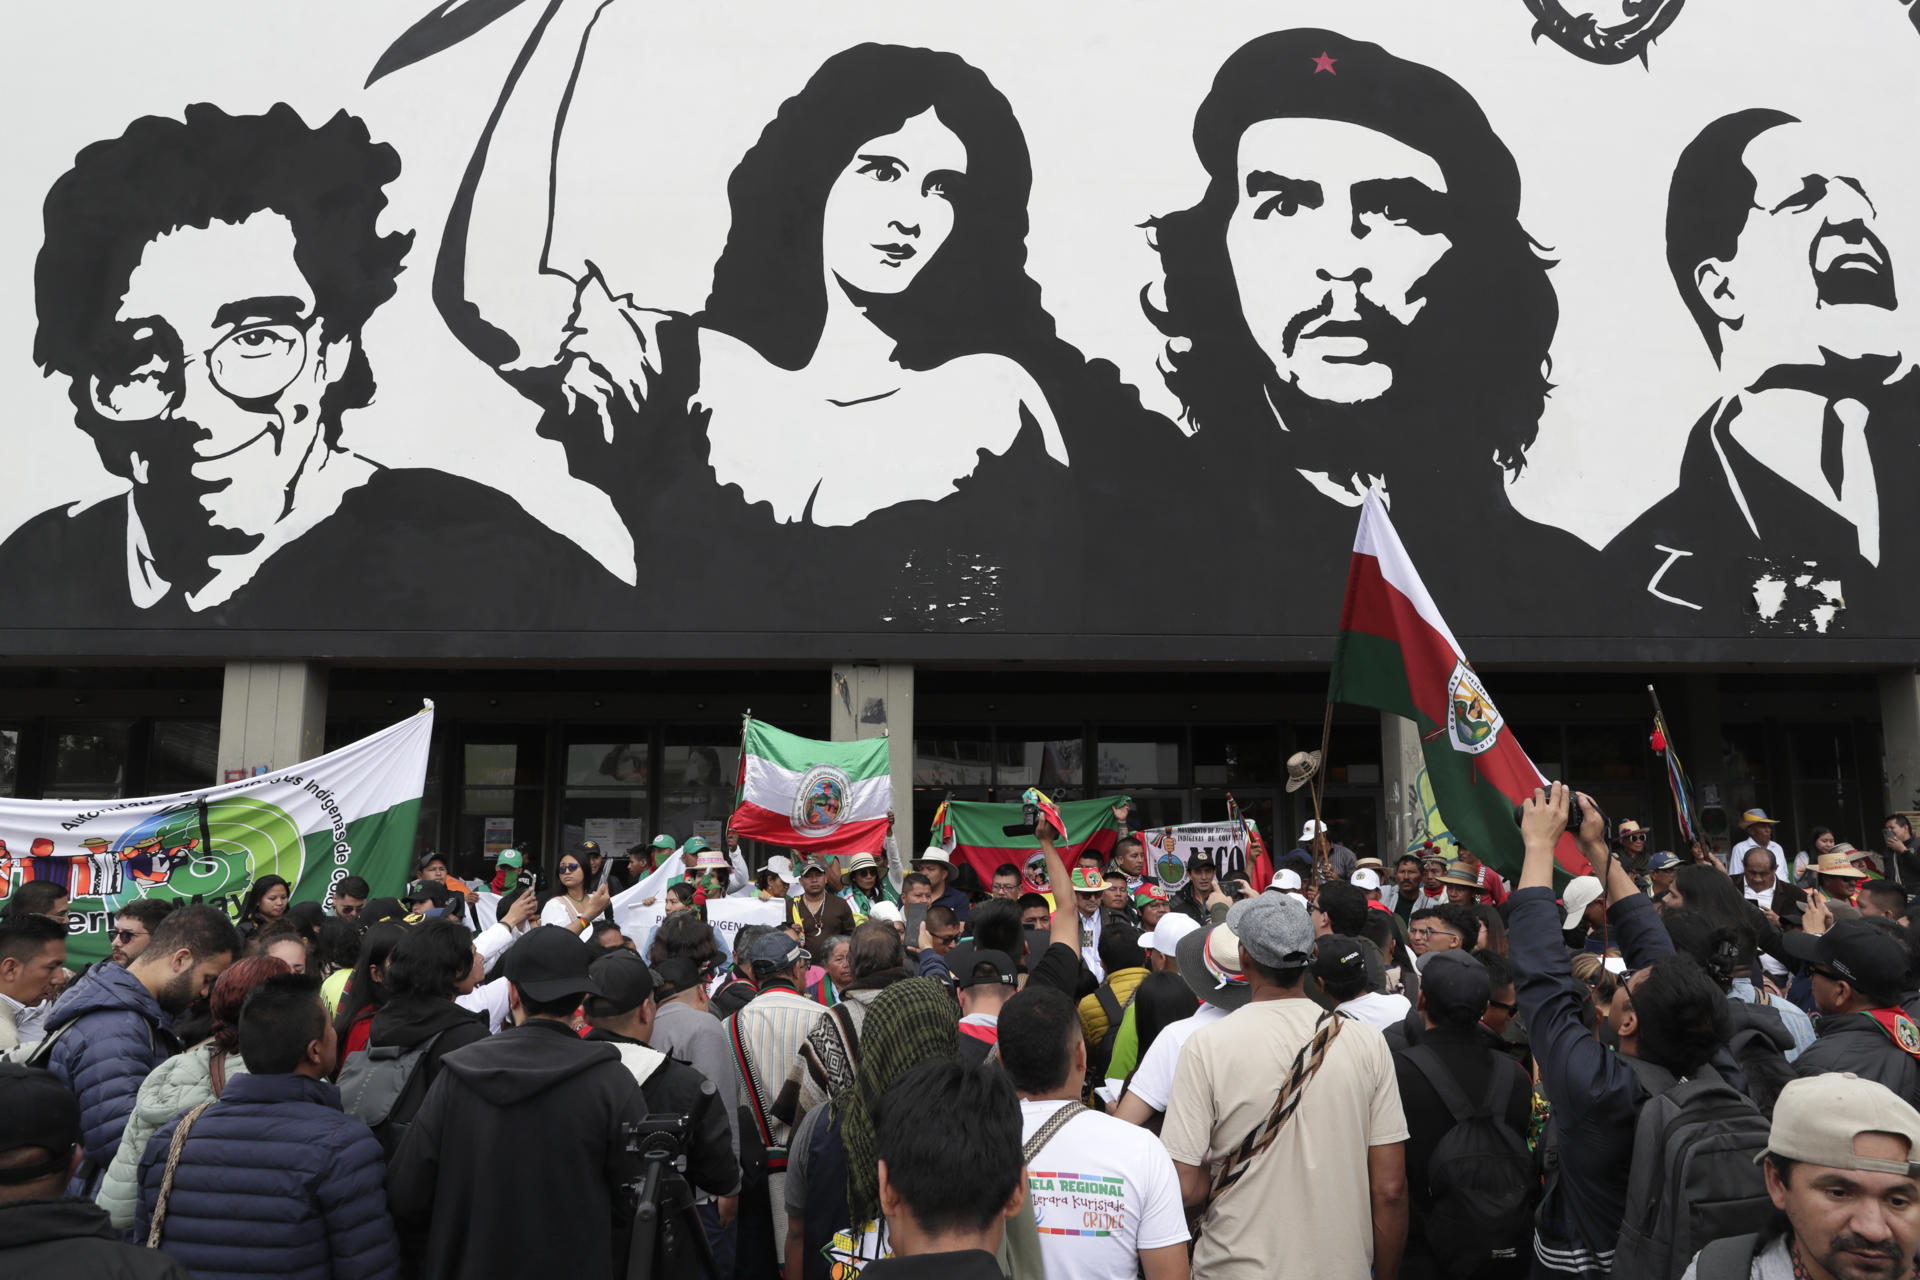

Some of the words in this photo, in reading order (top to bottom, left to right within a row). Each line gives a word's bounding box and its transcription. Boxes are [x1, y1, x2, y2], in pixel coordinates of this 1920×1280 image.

[303, 778, 346, 841] Indígenas
[335, 842, 350, 863] de
[1059, 1179, 1125, 1198] REGIONAL
